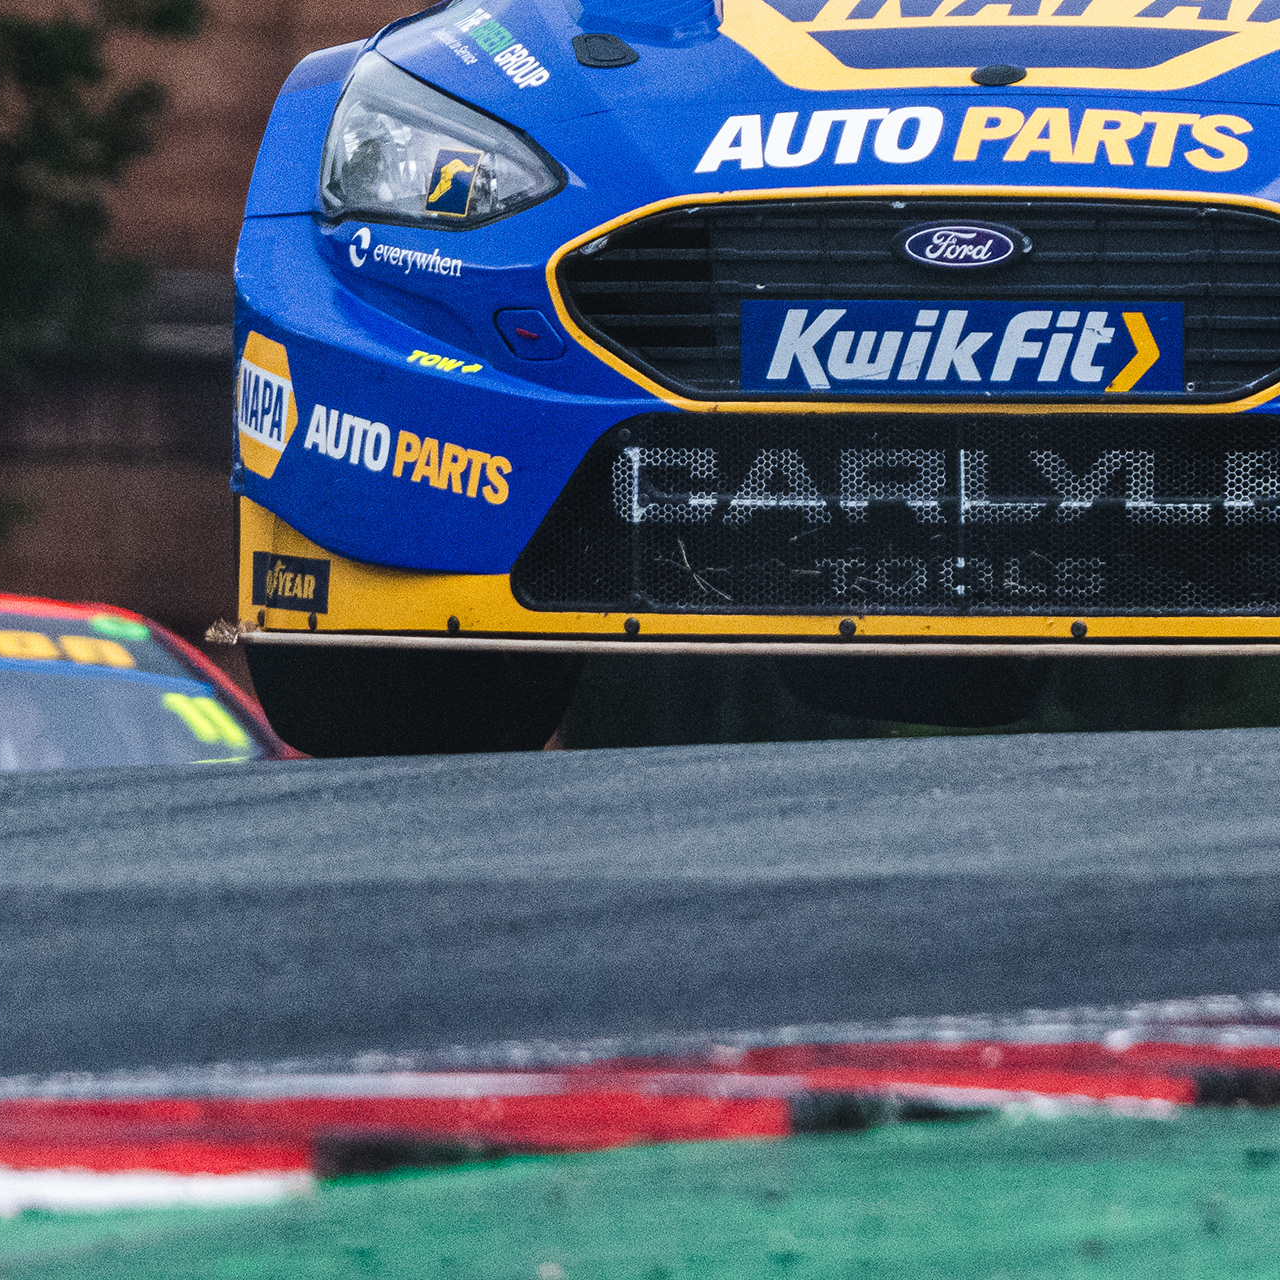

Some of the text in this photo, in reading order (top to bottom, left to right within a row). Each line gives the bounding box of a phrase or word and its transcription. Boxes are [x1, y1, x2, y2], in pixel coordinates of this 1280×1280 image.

[493, 42, 551, 90] GROUP
[694, 105, 1254, 175] AUTO PARTS
[373, 240, 463, 277] everywhen
[925, 230, 994, 260] Ford
[407, 349, 464, 373] TOW
[240, 367, 285, 444] NAPA
[304, 404, 513, 506] AUTO PARTS
[820, 556, 1106, 596] TOOLS
